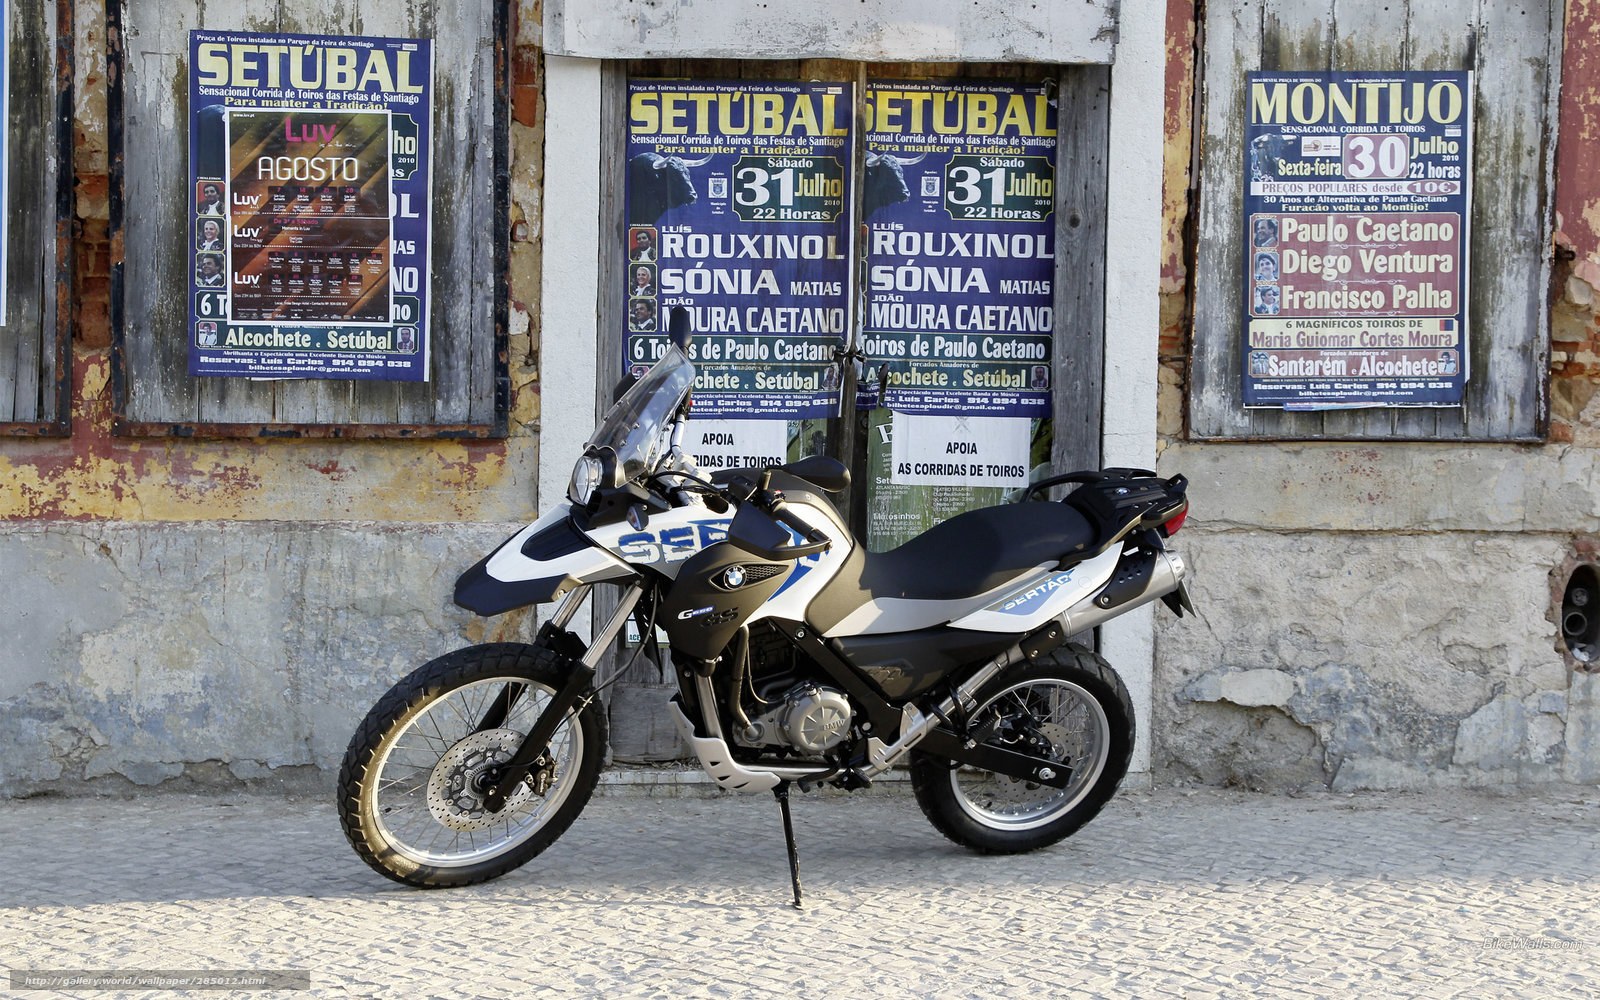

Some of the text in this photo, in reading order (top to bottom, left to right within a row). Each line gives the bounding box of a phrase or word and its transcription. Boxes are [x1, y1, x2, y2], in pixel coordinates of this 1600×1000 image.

[198, 42, 423, 94] SETÚBAL
[199, 85, 419, 105] Sensacional Corrida de Toiros das Festas de Santiago
[224, 97, 256, 106] Para
[261, 98, 309, 108] manter
[1251, 82, 1462, 124] MONTIJO
[630, 91, 848, 136] SETÚBAL
[285, 116, 337, 143] Luv
[1280, 125, 1426, 133] SENSACIONAL CORRIDA DE TOIROS
[631, 134, 844, 148] Sensacional Corrida de Toiros das Festas de Santiago
[895, 133, 1056, 148] Corrida de Toiros das Festas de Santiago
[655, 144, 814, 156] Para manter Tradição!
[869, 142, 1025, 156] Para manter Tradição!
[1278, 136, 1459, 178] Sexta-feira 30 Julho
[258, 156, 358, 181] AGOSTO
[767, 157, 813, 168] Sábado
[979, 156, 1025, 168] Sábado
[1409, 161, 1461, 179] 22 horas
[735, 167, 793, 206] 31
[794, 173, 841, 197] Julho
[947, 166, 1005, 205] 31
[1006, 172, 1052, 197] Julho
[1262, 181, 1452, 194] PREÇOS POPULARES desde 10€
[233, 192, 259, 205] Luv
[1369, 195, 1380, 203] de
[1382, 195, 1408, 203] Paulo
[1410, 195, 1448, 203] Caetano
[752, 207, 831, 220] 22 Horas
[964, 206, 1041, 219] 22 Horas
[1332, 203, 1360, 212] volta
[1381, 203, 1429, 212] Montijo!
[234, 224, 260, 237] Luv
[662, 224, 692, 233] LUÍS
[873, 222, 904, 230] LUÍS
[1282, 215, 1454, 242] Paulo Caetano
[662, 233, 845, 259] ROUXINOL
[873, 231, 1054, 259] ROUXINOL
[1282, 249, 1453, 281] Diego Ventura
[234, 271, 260, 284] Luv
[661, 261, 841, 296] SÓNIA MATIAS
[871, 259, 1050, 294] SÓNIA MATIAS
[662, 297, 694, 305] JOÃO
[872, 293, 904, 302] JOÃO
[1282, 282, 1452, 310] Francisco Palha
[201, 293, 212, 316] 6
[746, 307, 844, 333] CAETANO
[870, 303, 1053, 332] MOURA CAETANO
[1285, 319, 1423, 329] 6 MAGNÍFICOS TOIROS DE
[225, 327, 392, 350] Alcochete Setúbal
[910, 334, 929, 356] de
[934, 335, 977, 357] Paulo
[982, 336, 1046, 359] Caetano
[1252, 330, 1452, 347] Maria Guiomar Cortes Moura
[634, 337, 836, 361] 6 de Paulo Caetano
[200, 356, 257, 364] Reservas:
[1268, 354, 1347, 376] Santarém
[1359, 355, 1438, 376] Alcochete
[755, 371, 819, 390] Setúbal
[963, 368, 1026, 387] Setúbal
[702, 433, 734, 445] APOIA
[946, 441, 977, 454] APOIA
[726, 455, 782, 468] DE TOIROS
[897, 462, 1025, 478] AS CORRIDAS DE TOIROS
[823, 719, 846, 731] BMW
